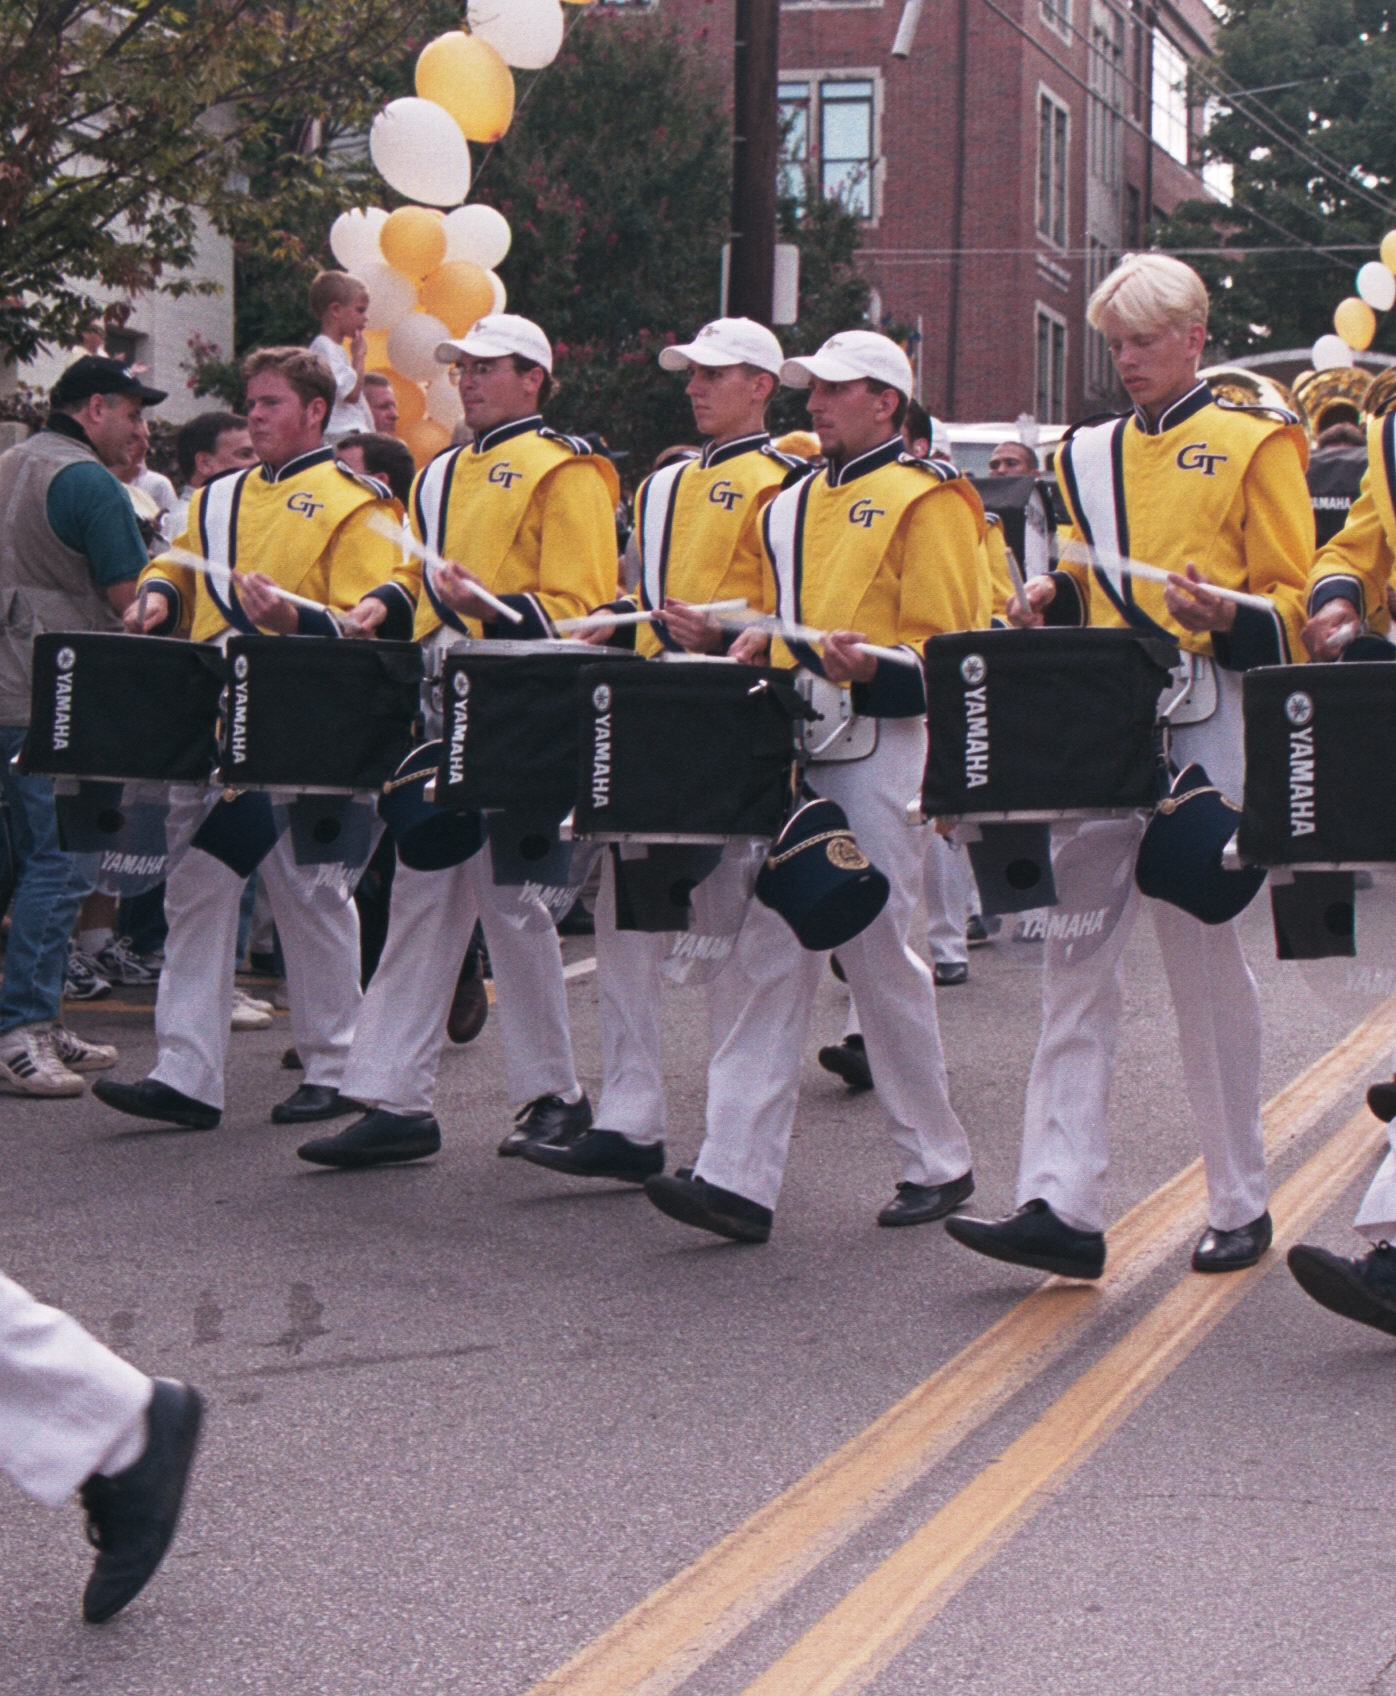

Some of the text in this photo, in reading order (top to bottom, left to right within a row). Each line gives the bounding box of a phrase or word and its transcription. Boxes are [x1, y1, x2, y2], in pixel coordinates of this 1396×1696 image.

[489, 460, 523, 489] GT
[1176, 441, 1228, 476] GT
[286, 490, 325, 519] GT
[709, 480, 744, 511] GT
[849, 498, 886, 529] GT
[53, 671, 73, 750] YAMAHA
[231, 681, 248, 764] YAMAHA
[964, 685, 989, 789] YAMAHA
[448, 698, 468, 785] YAMAHA
[592, 713, 611, 808] YAMAHA
[1289, 726, 1316, 837] YAMAHA
[100, 850, 165, 875] YAMAHA
